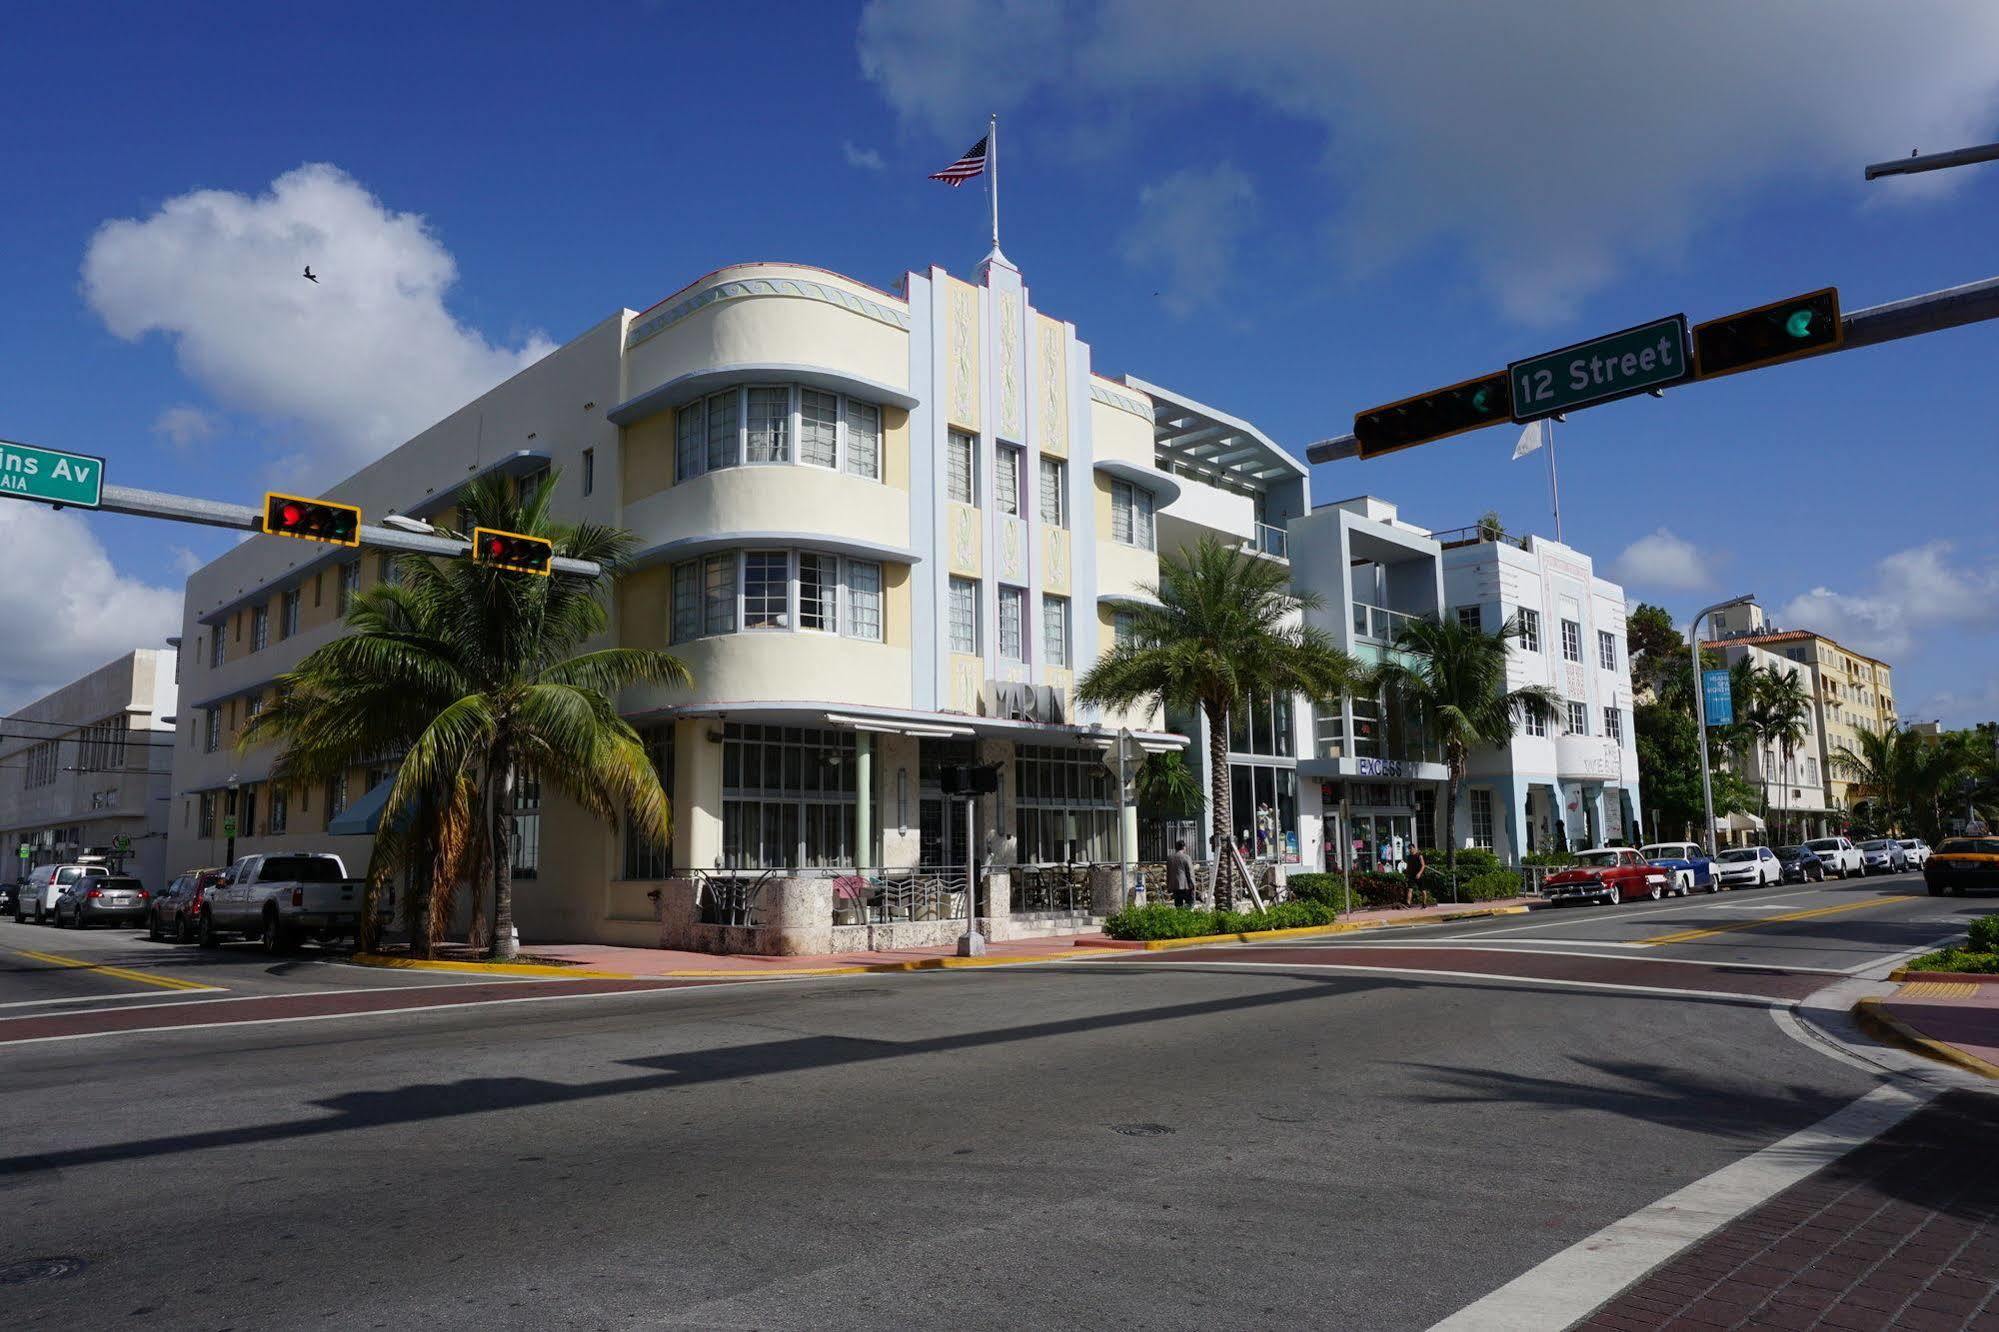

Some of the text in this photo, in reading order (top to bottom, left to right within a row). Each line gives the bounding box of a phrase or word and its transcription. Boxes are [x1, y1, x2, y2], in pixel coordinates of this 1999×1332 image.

[1521, 335, 1673, 403] 12 Street
[51, 458, 90, 484] Av
[1360, 758, 1402, 777] EXCESS
